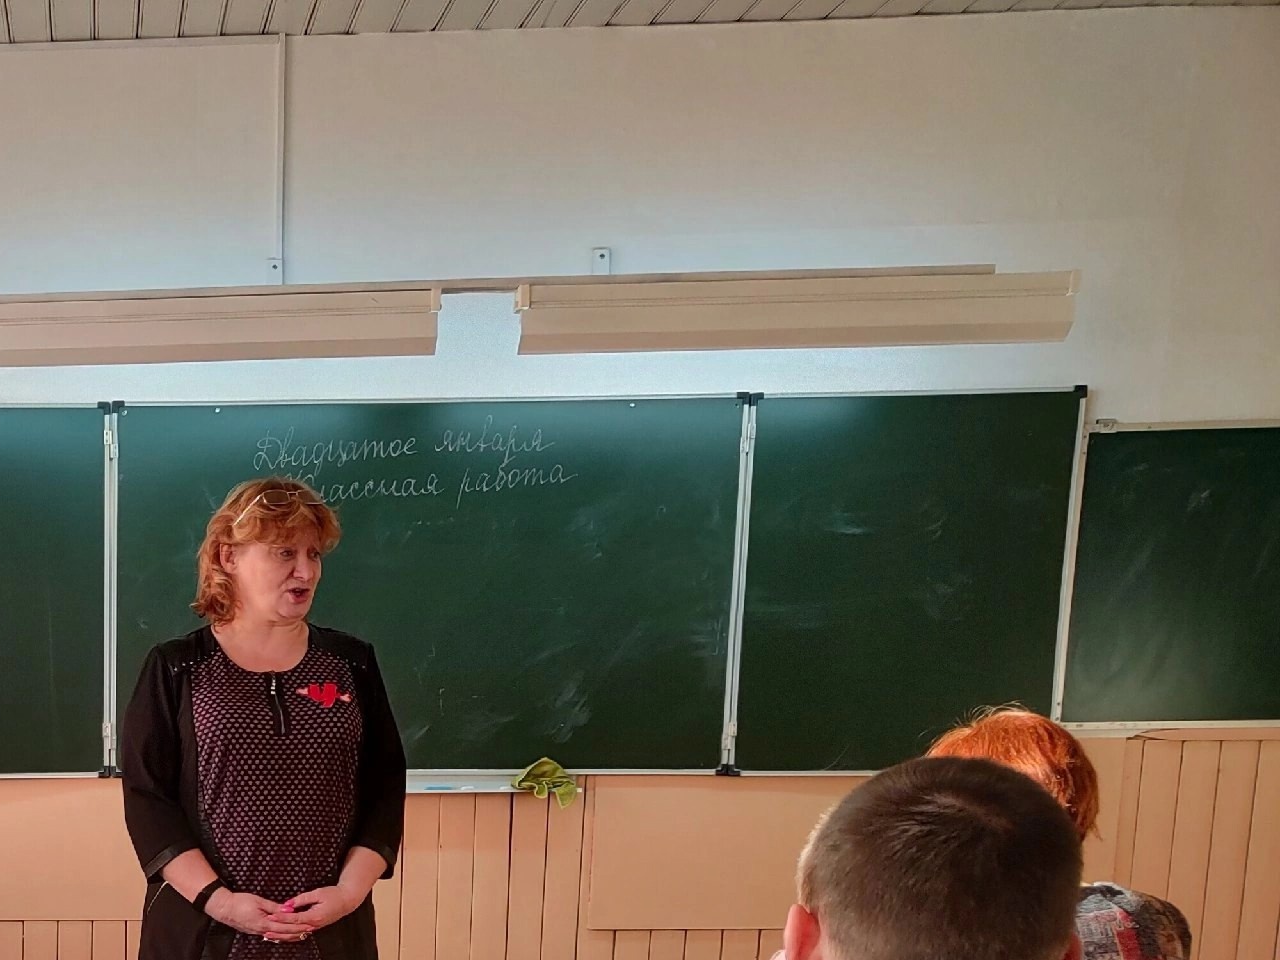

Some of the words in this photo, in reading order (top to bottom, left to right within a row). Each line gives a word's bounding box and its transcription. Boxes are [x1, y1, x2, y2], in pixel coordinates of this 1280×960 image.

[253, 426, 419, 475] Двадцатое
[434, 414, 556, 467] января
[456, 456, 579, 510] работа
